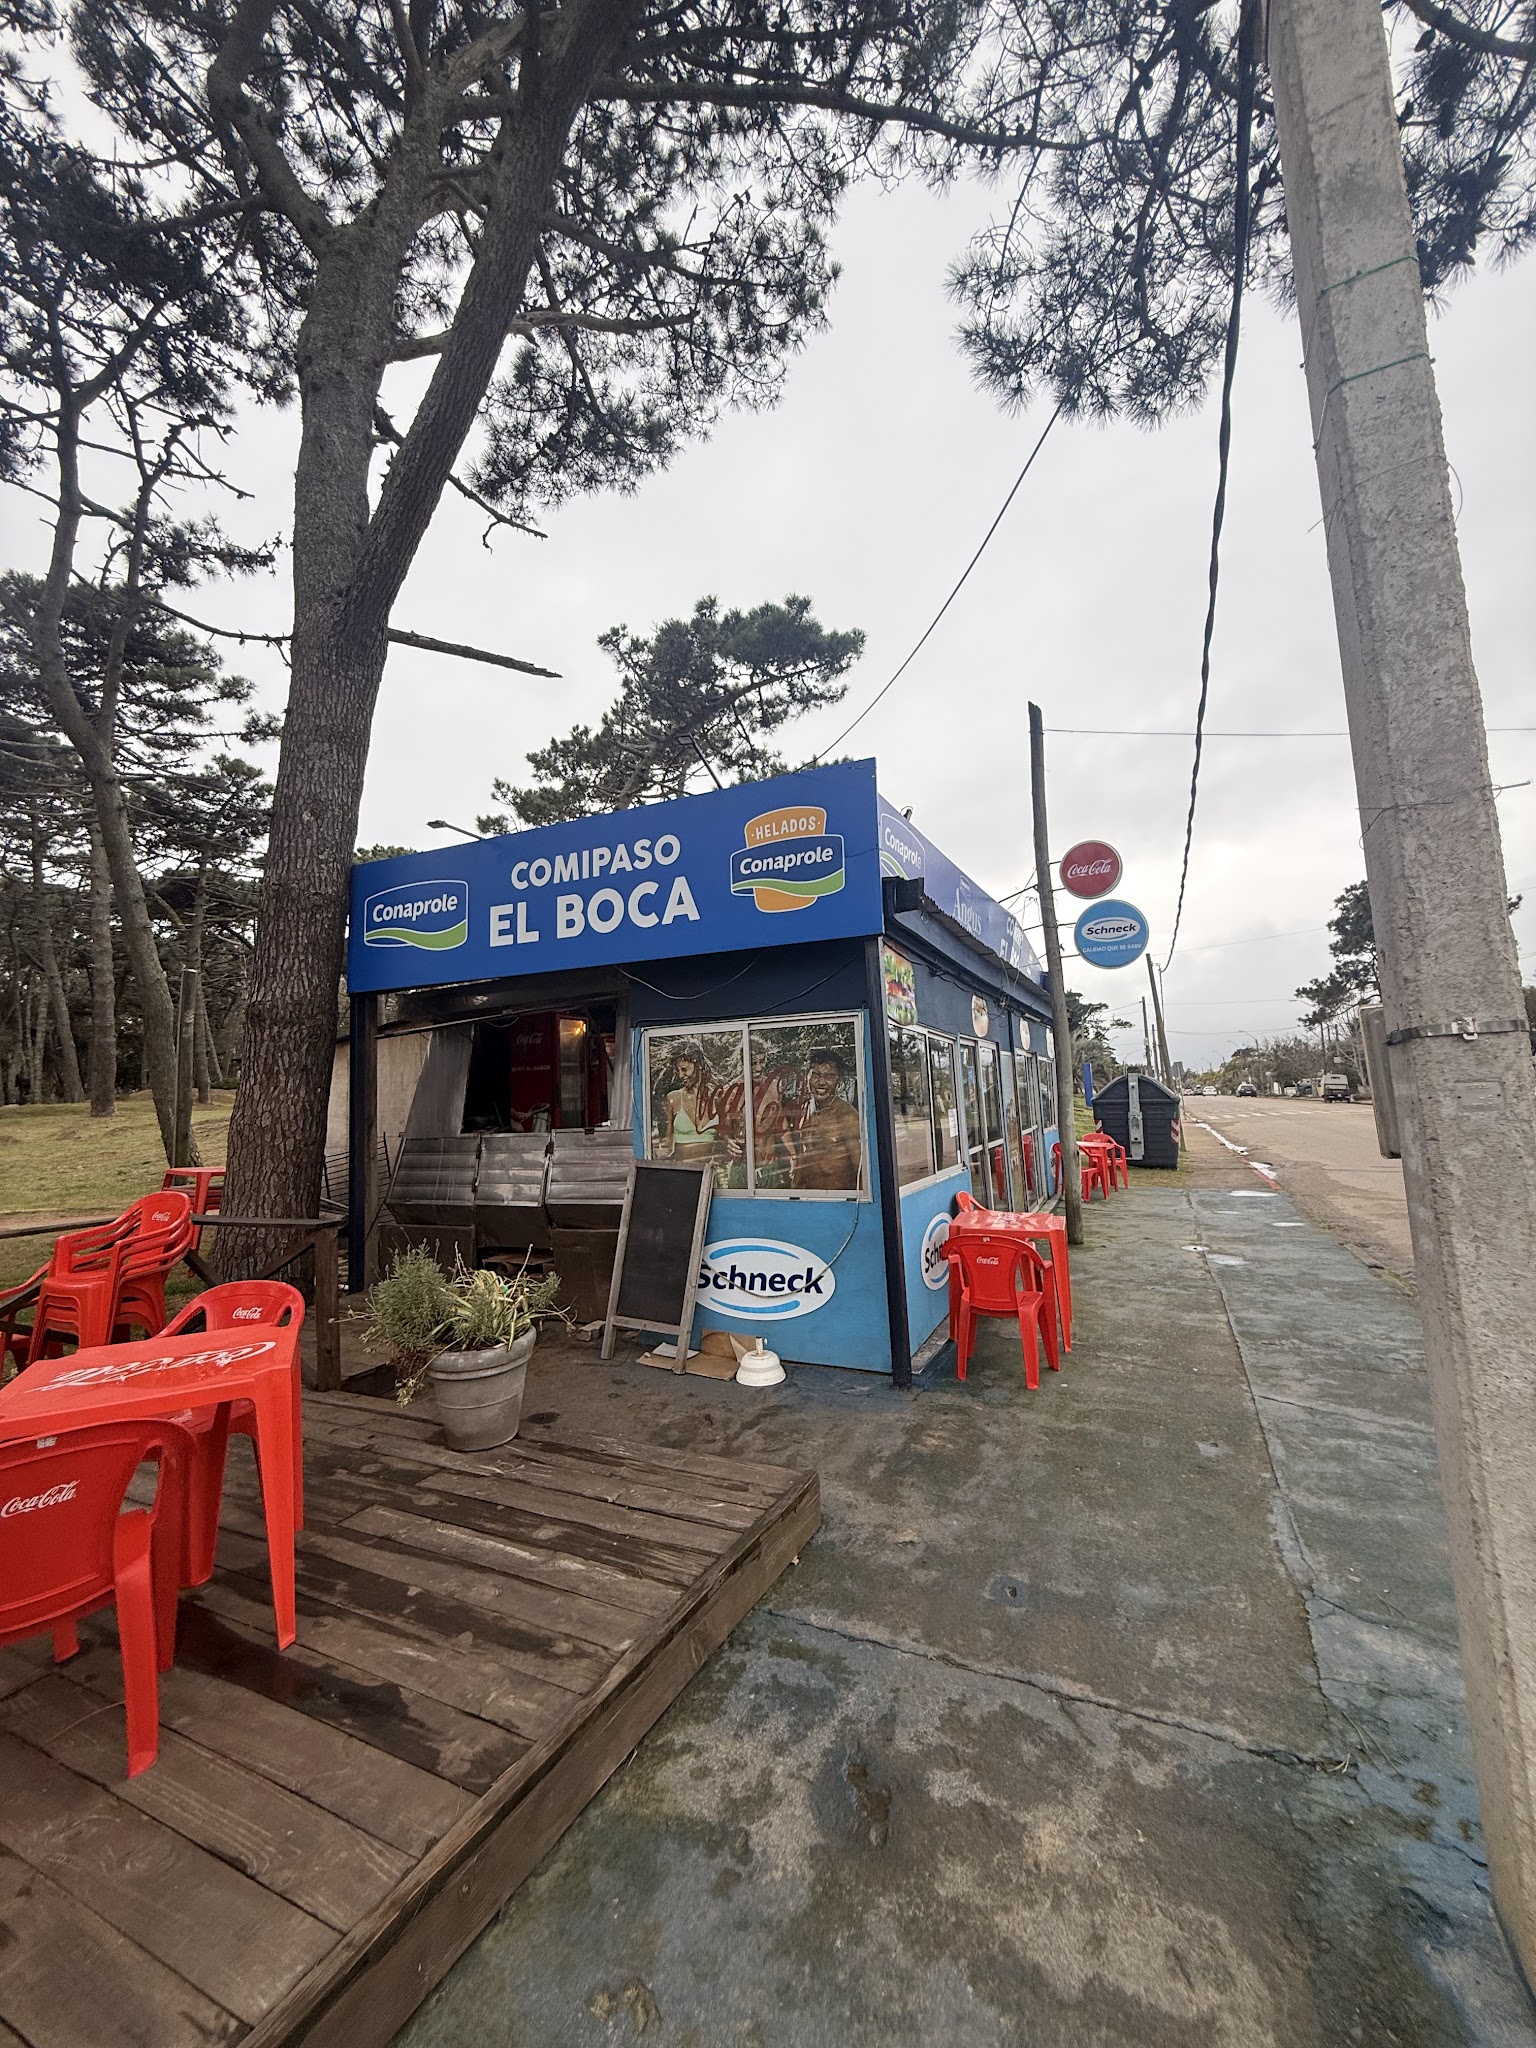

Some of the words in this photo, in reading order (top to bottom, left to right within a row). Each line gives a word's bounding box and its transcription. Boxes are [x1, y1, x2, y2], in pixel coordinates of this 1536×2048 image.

[755, 815, 817, 841] HELADOS
[511, 834, 681, 890] COMIPASO
[740, 846, 834, 875] Conaprole
[884, 827, 922, 870] Conaprole
[1067, 858, 1114, 879] Coca-Cola
[372, 893, 458, 922] Conaprole
[490, 901, 540, 947] EL
[557, 876, 700, 939] BOCA
[953, 887, 982, 935] Angus
[1086, 923, 1137, 936] Schneck
[697, 1264, 825, 1295] Schneck
[0, 1479, 81, 1518] Coca-Cola
